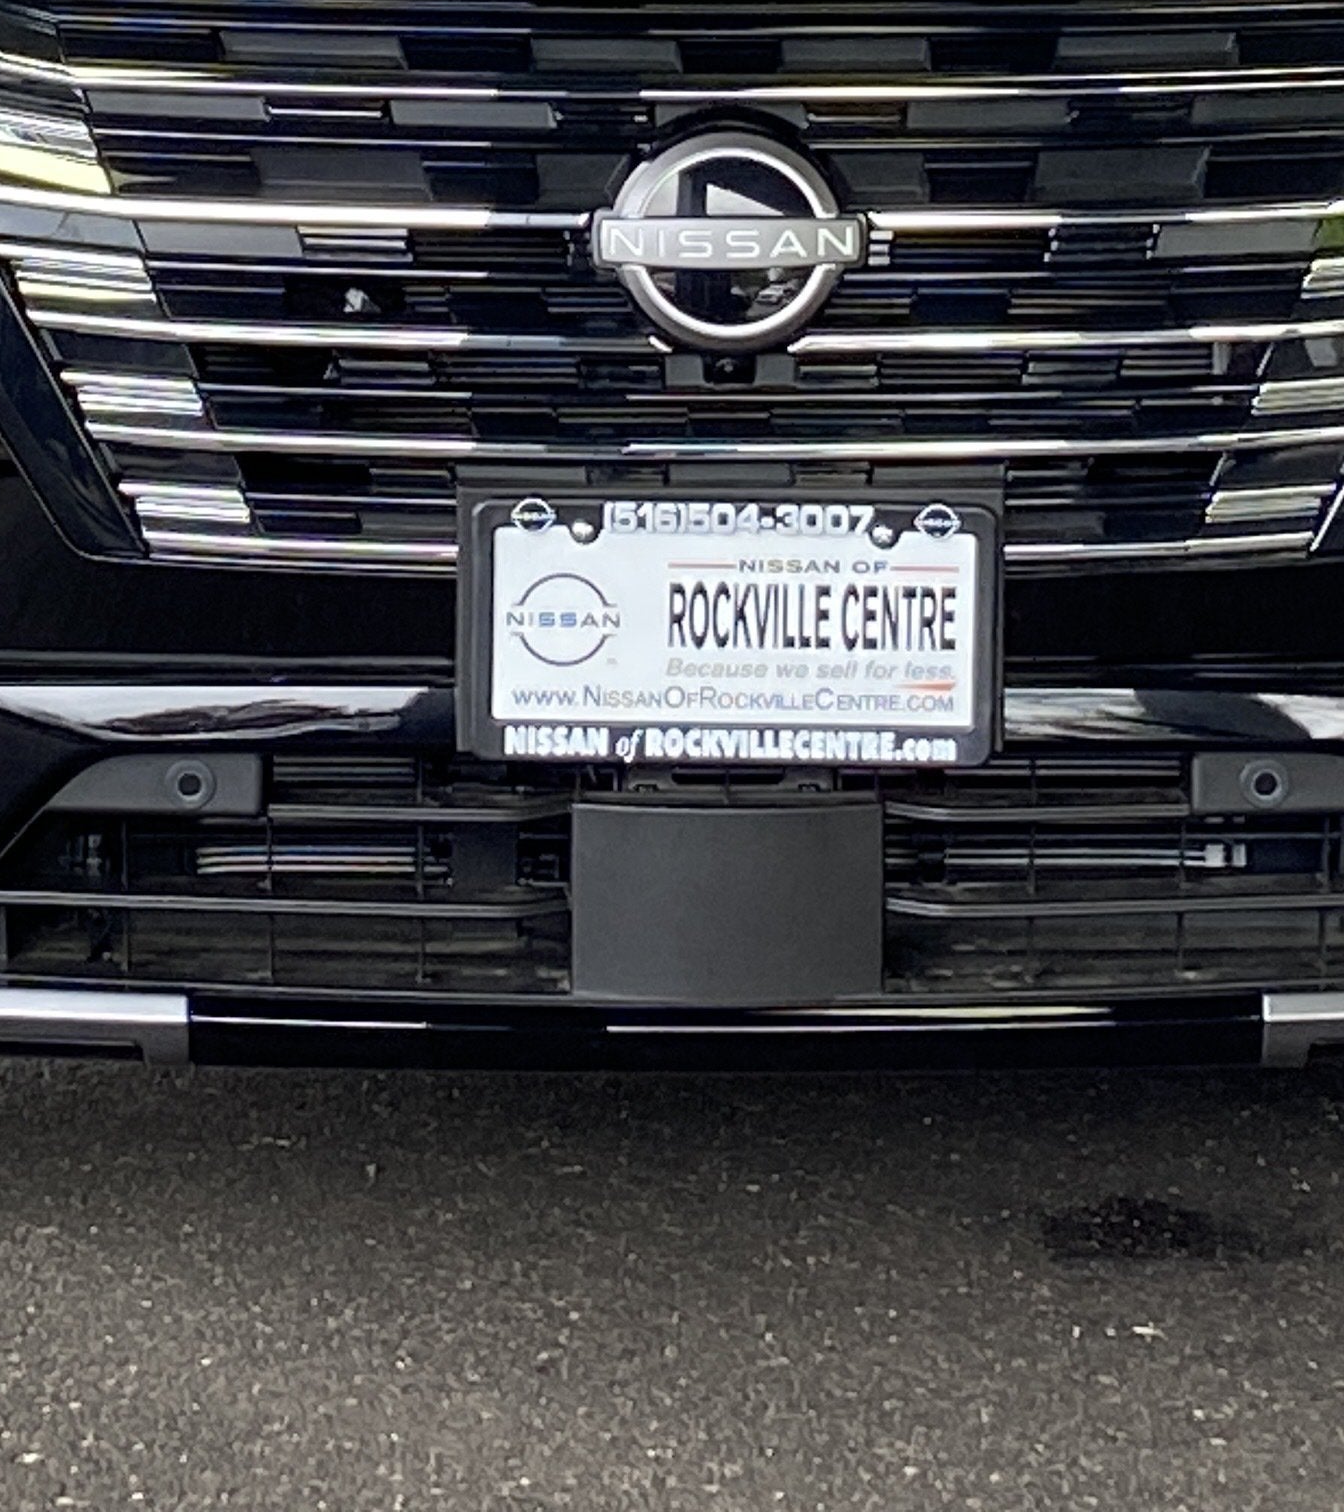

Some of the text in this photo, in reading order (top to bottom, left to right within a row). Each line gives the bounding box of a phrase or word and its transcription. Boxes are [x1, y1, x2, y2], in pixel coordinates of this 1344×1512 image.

[608, 226, 854, 259] NISSAN
[605, 502, 874, 536] (516)504-3007
[738, 560, 889, 574] NISSAN OF
[506, 611, 621, 628] NISSAN
[668, 581, 957, 652] ROCKVILLE CENTRE
[665, 657, 956, 681] Because we sell for less.
[504, 725, 956, 763] NISSAN of ROCKVILLECENTRE.com
